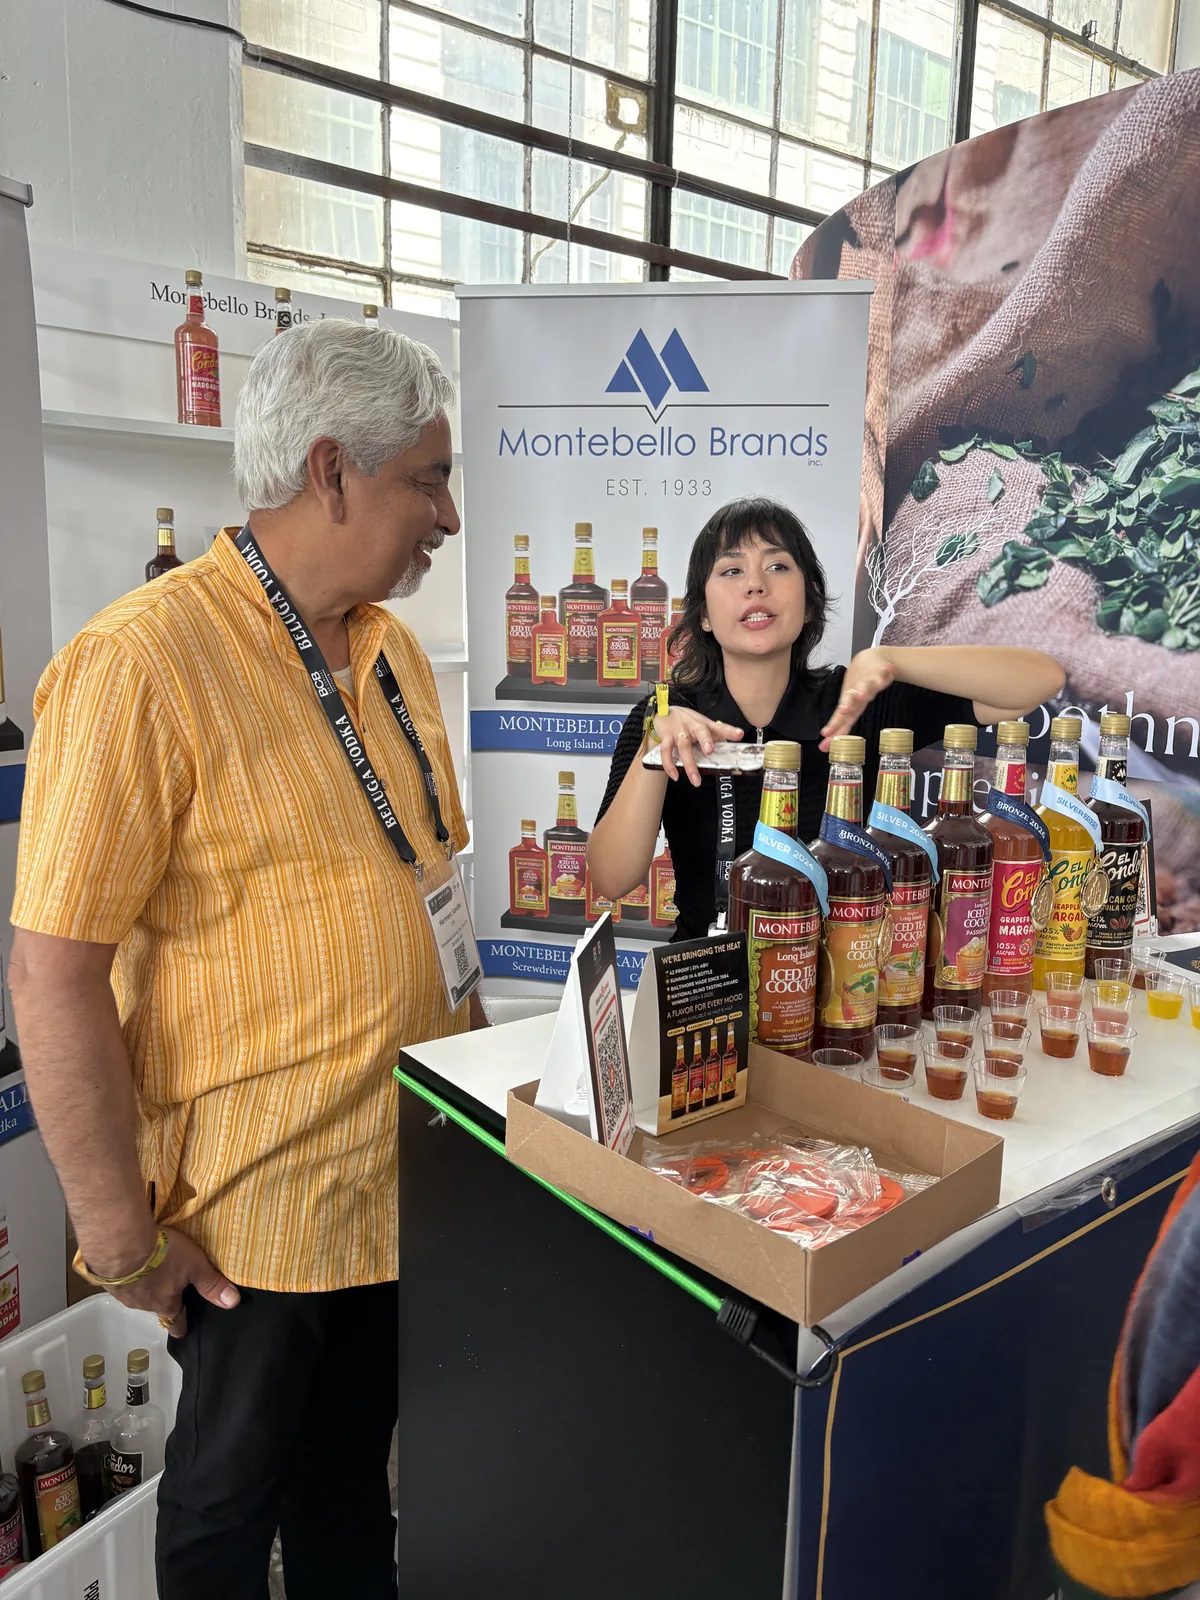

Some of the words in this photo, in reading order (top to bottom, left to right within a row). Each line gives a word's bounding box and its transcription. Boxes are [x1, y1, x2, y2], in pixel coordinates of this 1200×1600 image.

[150, 282, 248, 315] Monebello
[254, 301, 310, 325] Brads
[498, 426, 697, 457] Montebello
[710, 426, 828, 457] Brands
[807, 458, 823, 467] inc.
[606, 479, 648, 496] EST.
[661, 479, 713, 496] 1933
[566, 603, 603, 611] MONTEBELLO
[634, 604, 667, 612] MONTEBELLO
[271, 591, 313, 650] BELUGA
[311, 671, 329, 698] BCB
[499, 715, 623, 735] MONTEBELLO
[335, 714, 366, 768] VODKA
[546, 737, 572, 751] Long
[573, 739, 604, 749] Island
[362, 768, 397, 829] BELUGA
[1056, 796, 1084, 817] SILVER
[997, 800, 1029, 821] BRONZE
[721, 803, 734, 843] VODKA
[876, 811, 908, 830] SILVER
[909, 827, 928, 844] 2024
[838, 829, 875, 853] BRONZE
[757, 832, 792, 855] SILVER
[792, 849, 814, 871] 2024
[1117, 852, 1130, 865] EL
[1070, 860, 1084, 874] EL
[1024, 871, 1036, 885] EL
[967, 910, 984, 919] ICED
[915, 919, 926, 930] TEA
[661, 953, 681, 964] WE'RE
[682, 947, 713, 960] BRINGING
[714, 944, 726, 953] THE
[726, 941, 741, 951] HEAT
[850, 940, 873, 951] ICED
[902, 941, 919, 949] PEACH
[777, 952, 799, 963] Long
[512, 961, 568, 977] Screwdriver
[670, 974, 688, 983] SUMMER
[698, 969, 713, 977] BOTTLE
[675, 966, 690, 974] PROOF
[770, 968, 802, 982] ICED
[803, 964, 817, 978] TEA
[670, 981, 695, 991] BALTIMORE
[708, 975, 720, 983] SINCE
[671, 989, 692, 999] NATIONAL
[693, 987, 706, 995] BLIND
[706, 982, 723, 991] TASTING
[666, 1011, 672, 1019] A
[672, 1006, 694, 1017] FLAVOR
[694, 1002, 707, 1011] FOR
[707, 997, 724, 1009] EVERY
[724, 993, 743, 1004] MOOD
[671, 997, 689, 1006] WINNER
